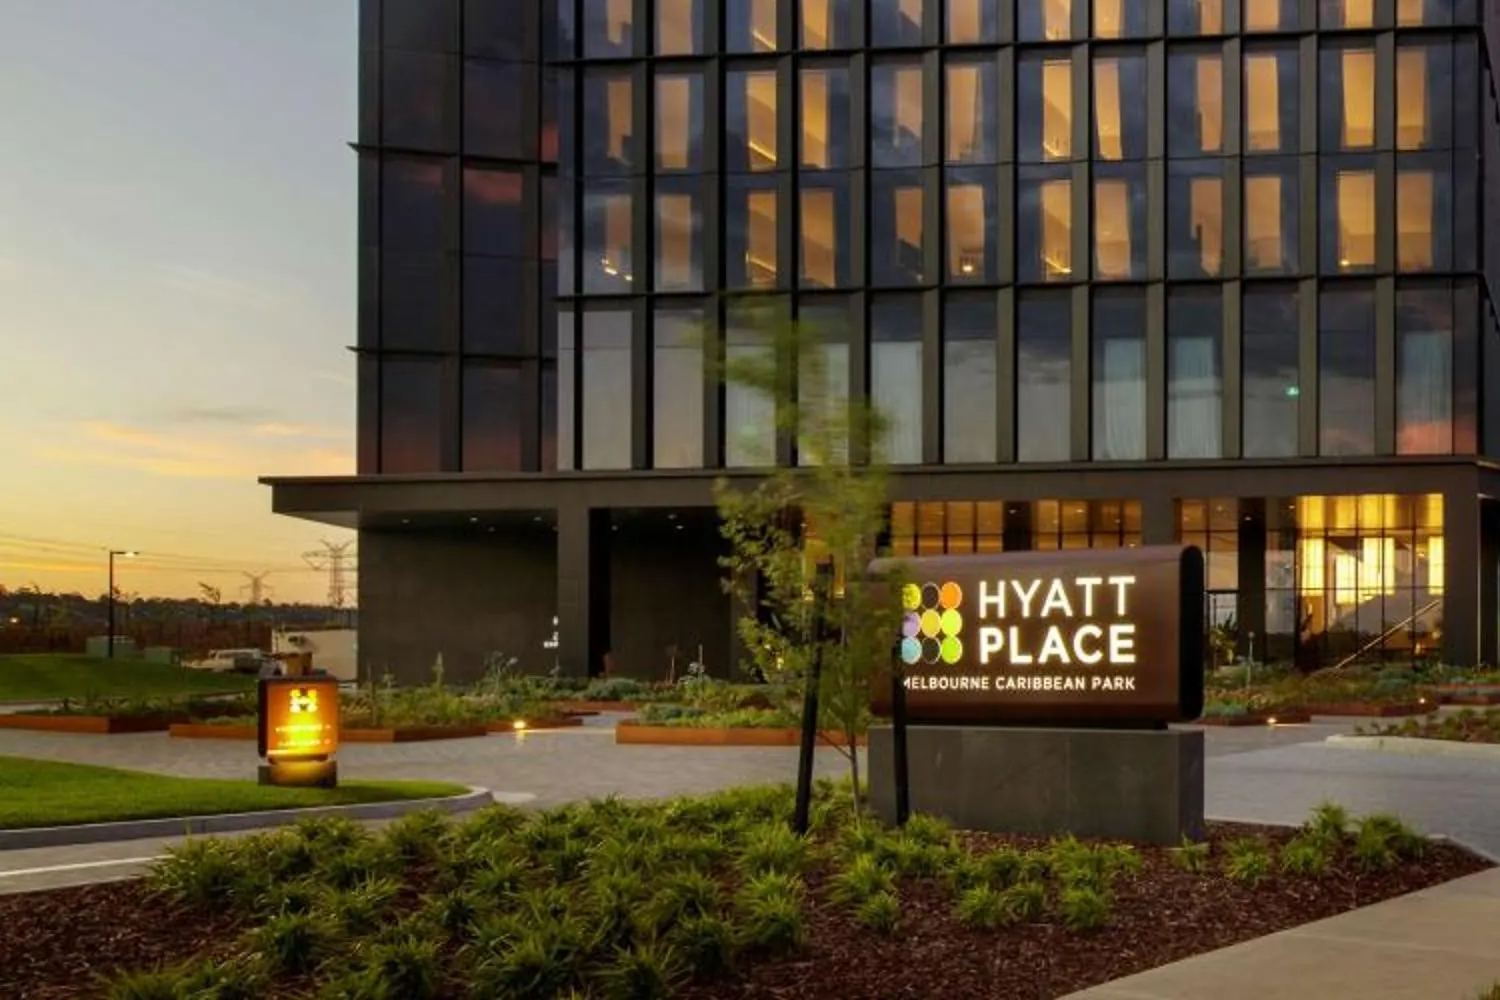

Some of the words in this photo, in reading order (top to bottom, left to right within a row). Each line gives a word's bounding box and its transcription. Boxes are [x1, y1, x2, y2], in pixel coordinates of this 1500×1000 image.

[979, 575, 1136, 619] HYATT
[979, 623, 1136, 665] PLACE
[995, 676, 1086, 690] CARIBBEAN
[1091, 676, 1136, 690] PARK
